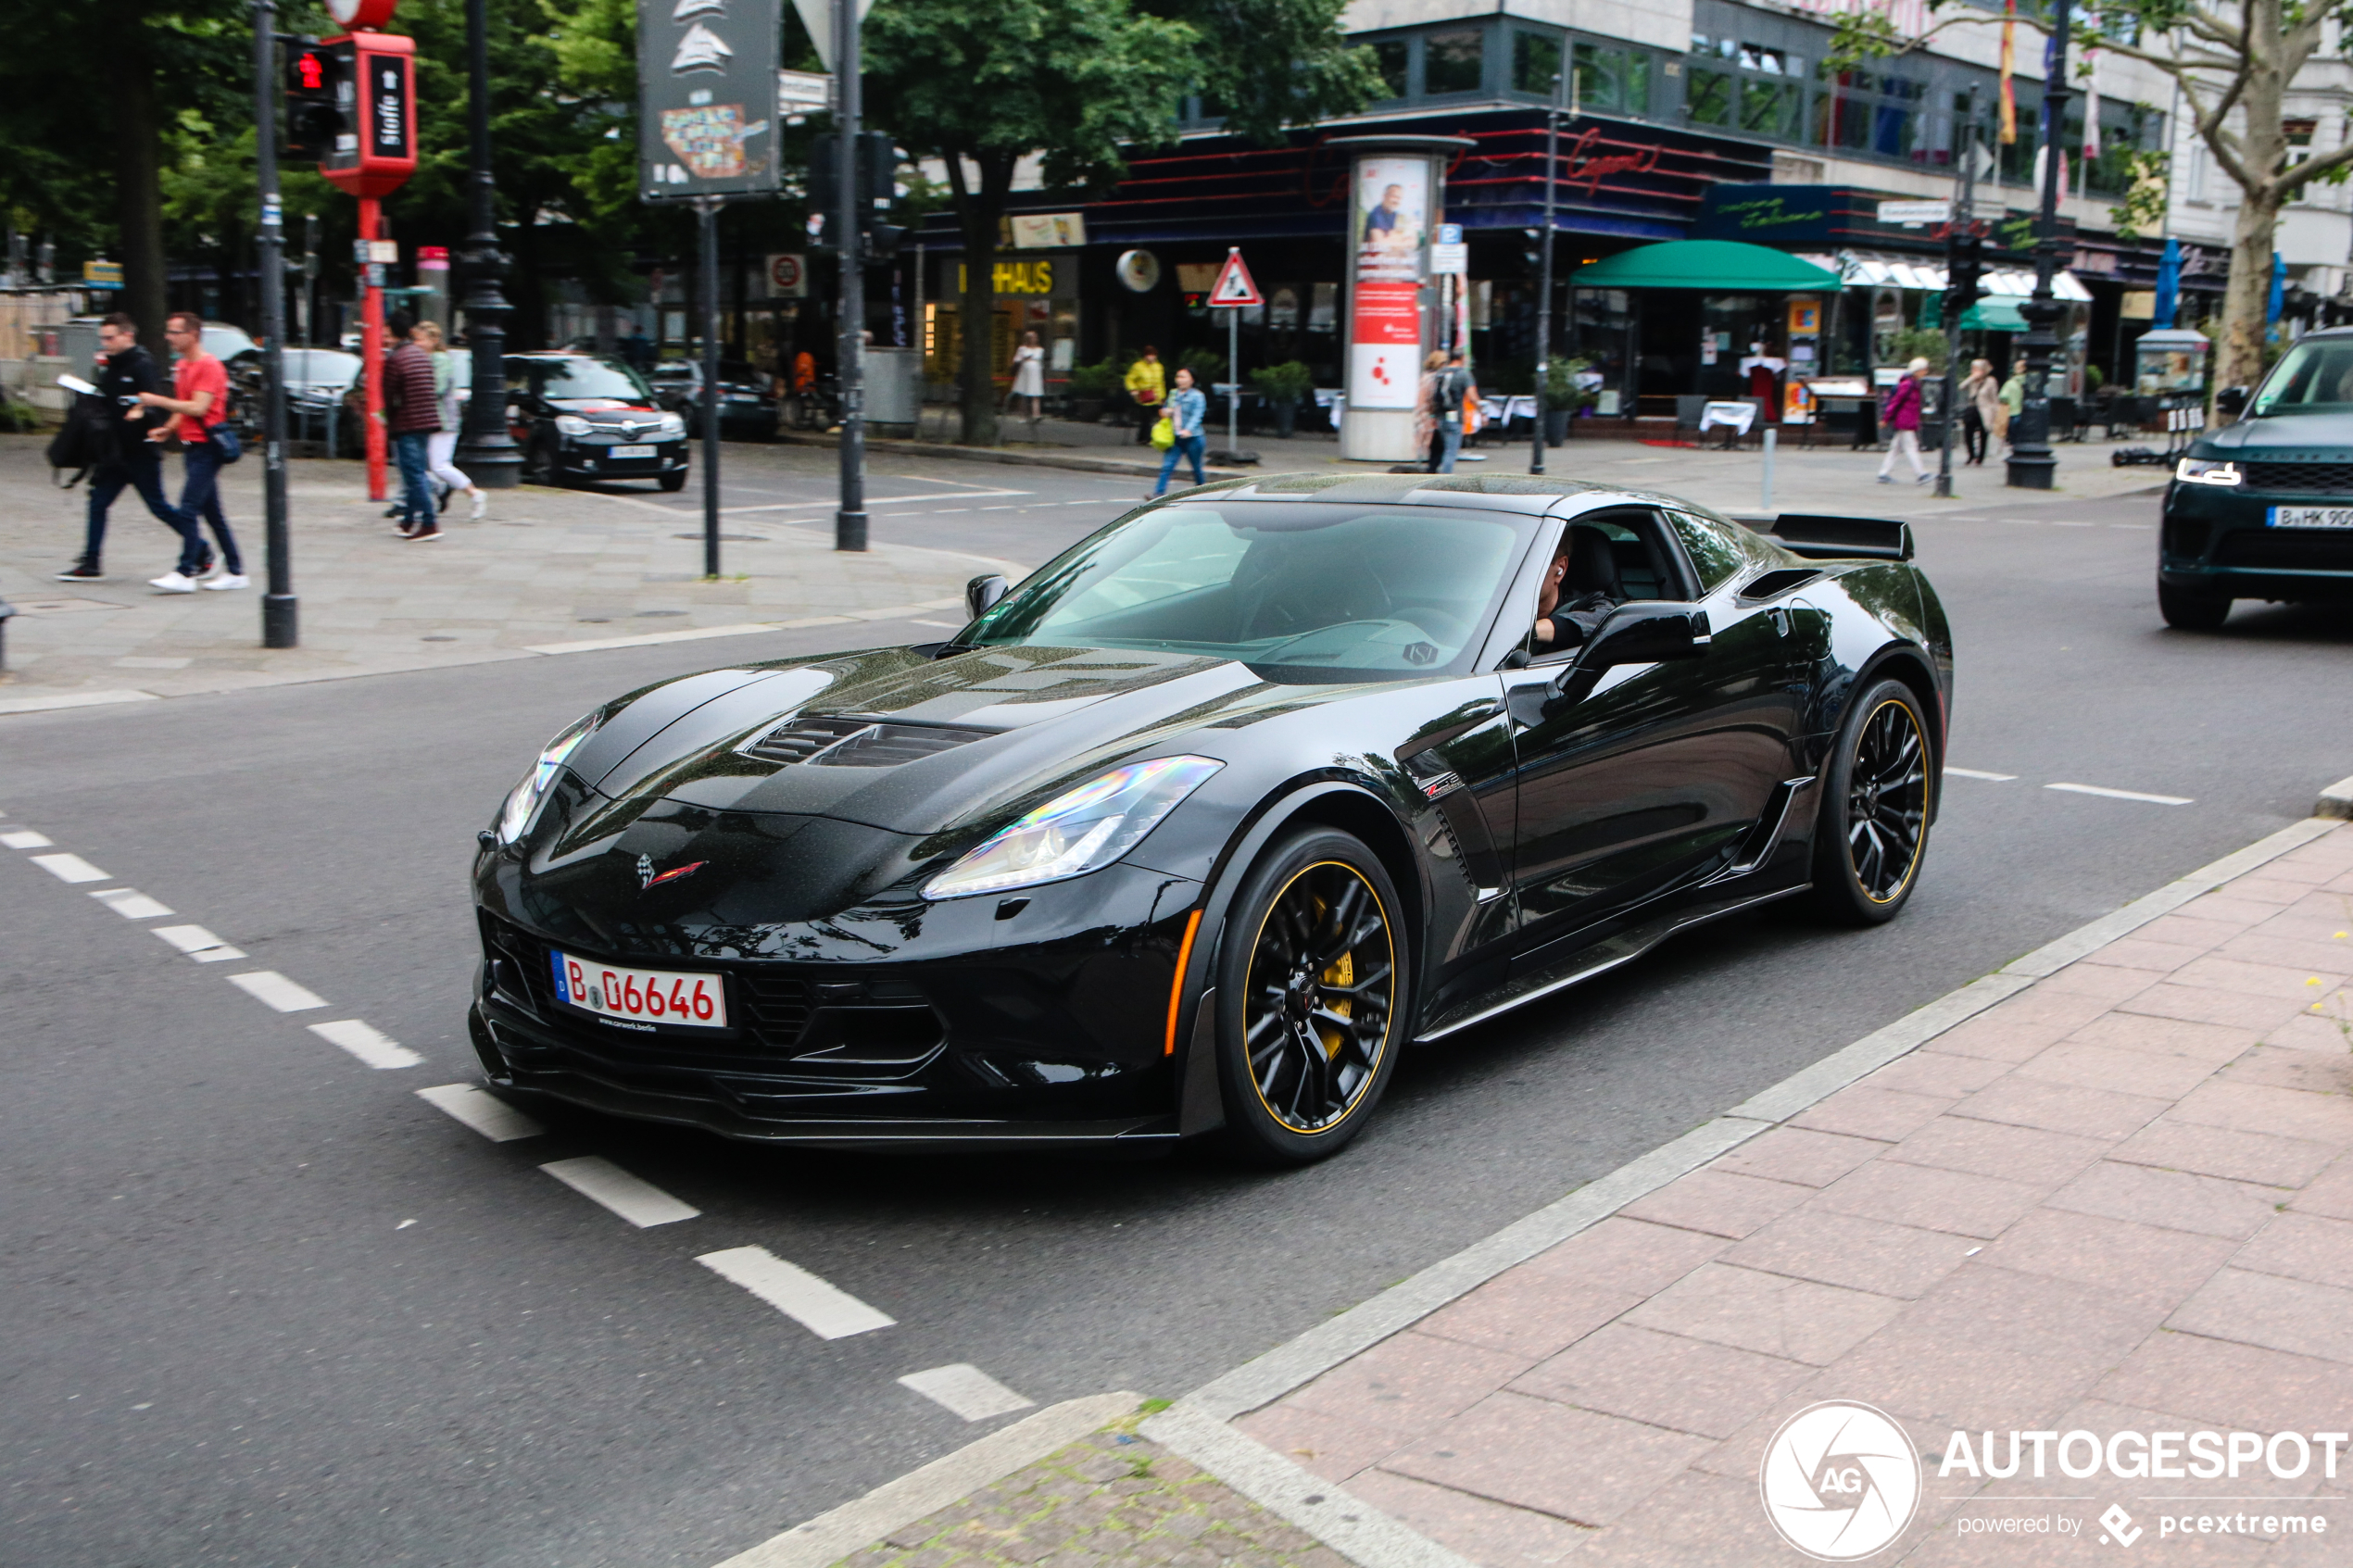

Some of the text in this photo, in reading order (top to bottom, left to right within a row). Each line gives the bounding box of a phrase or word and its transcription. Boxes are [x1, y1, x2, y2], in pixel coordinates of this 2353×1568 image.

[2282, 509, 2292, 525] B
[2303, 509, 2324, 525] HK
[558, 980, 566, 992] D
[569, 960, 586, 1001] B
